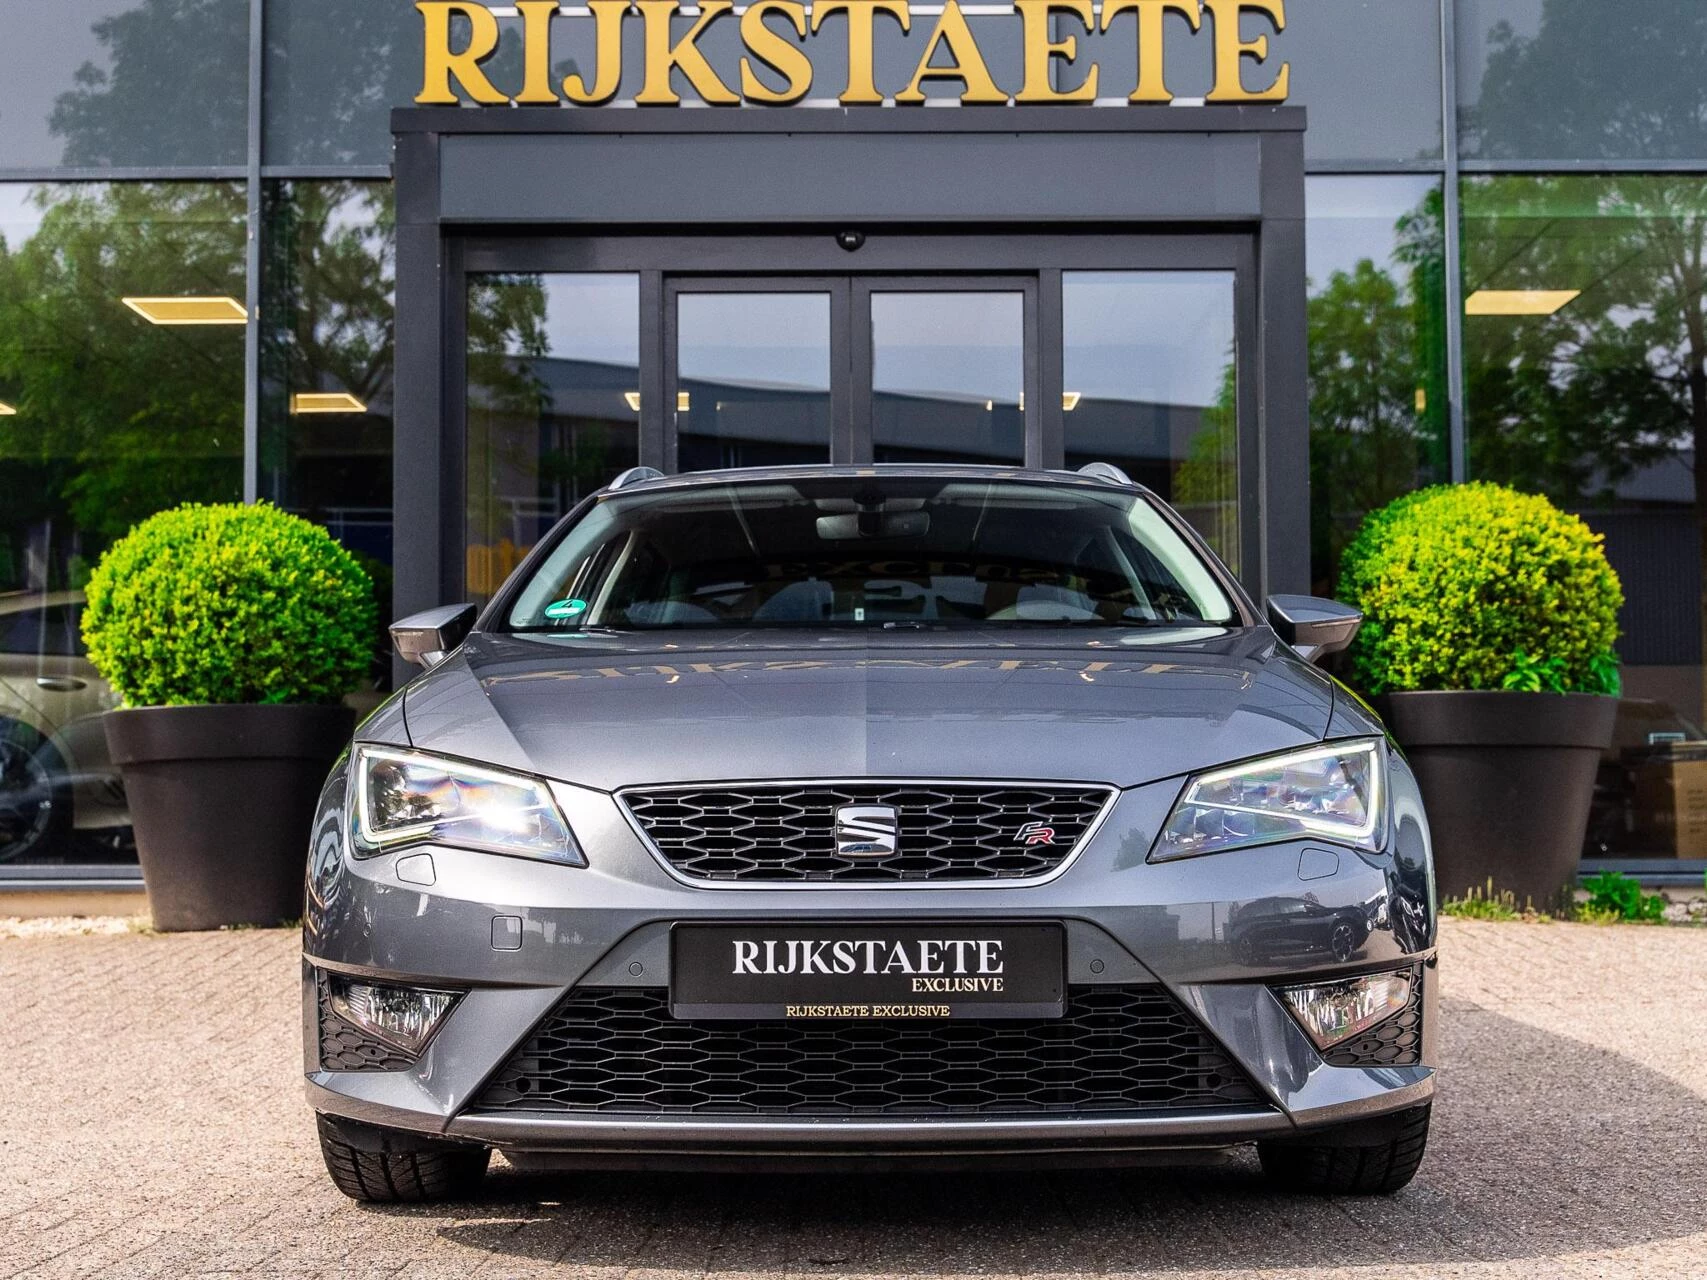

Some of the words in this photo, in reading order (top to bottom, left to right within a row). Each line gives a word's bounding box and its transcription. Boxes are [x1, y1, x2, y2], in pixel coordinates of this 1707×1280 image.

[414, 0, 1290, 104] RIJKSTAETE
[732, 940, 1004, 974] RIJKSTAETE
[911, 977, 1004, 992] EXCLUSIVE
[785, 1005, 869, 1017] RIJKSTAETE
[872, 1005, 950, 1017] EXCLUSIVE
